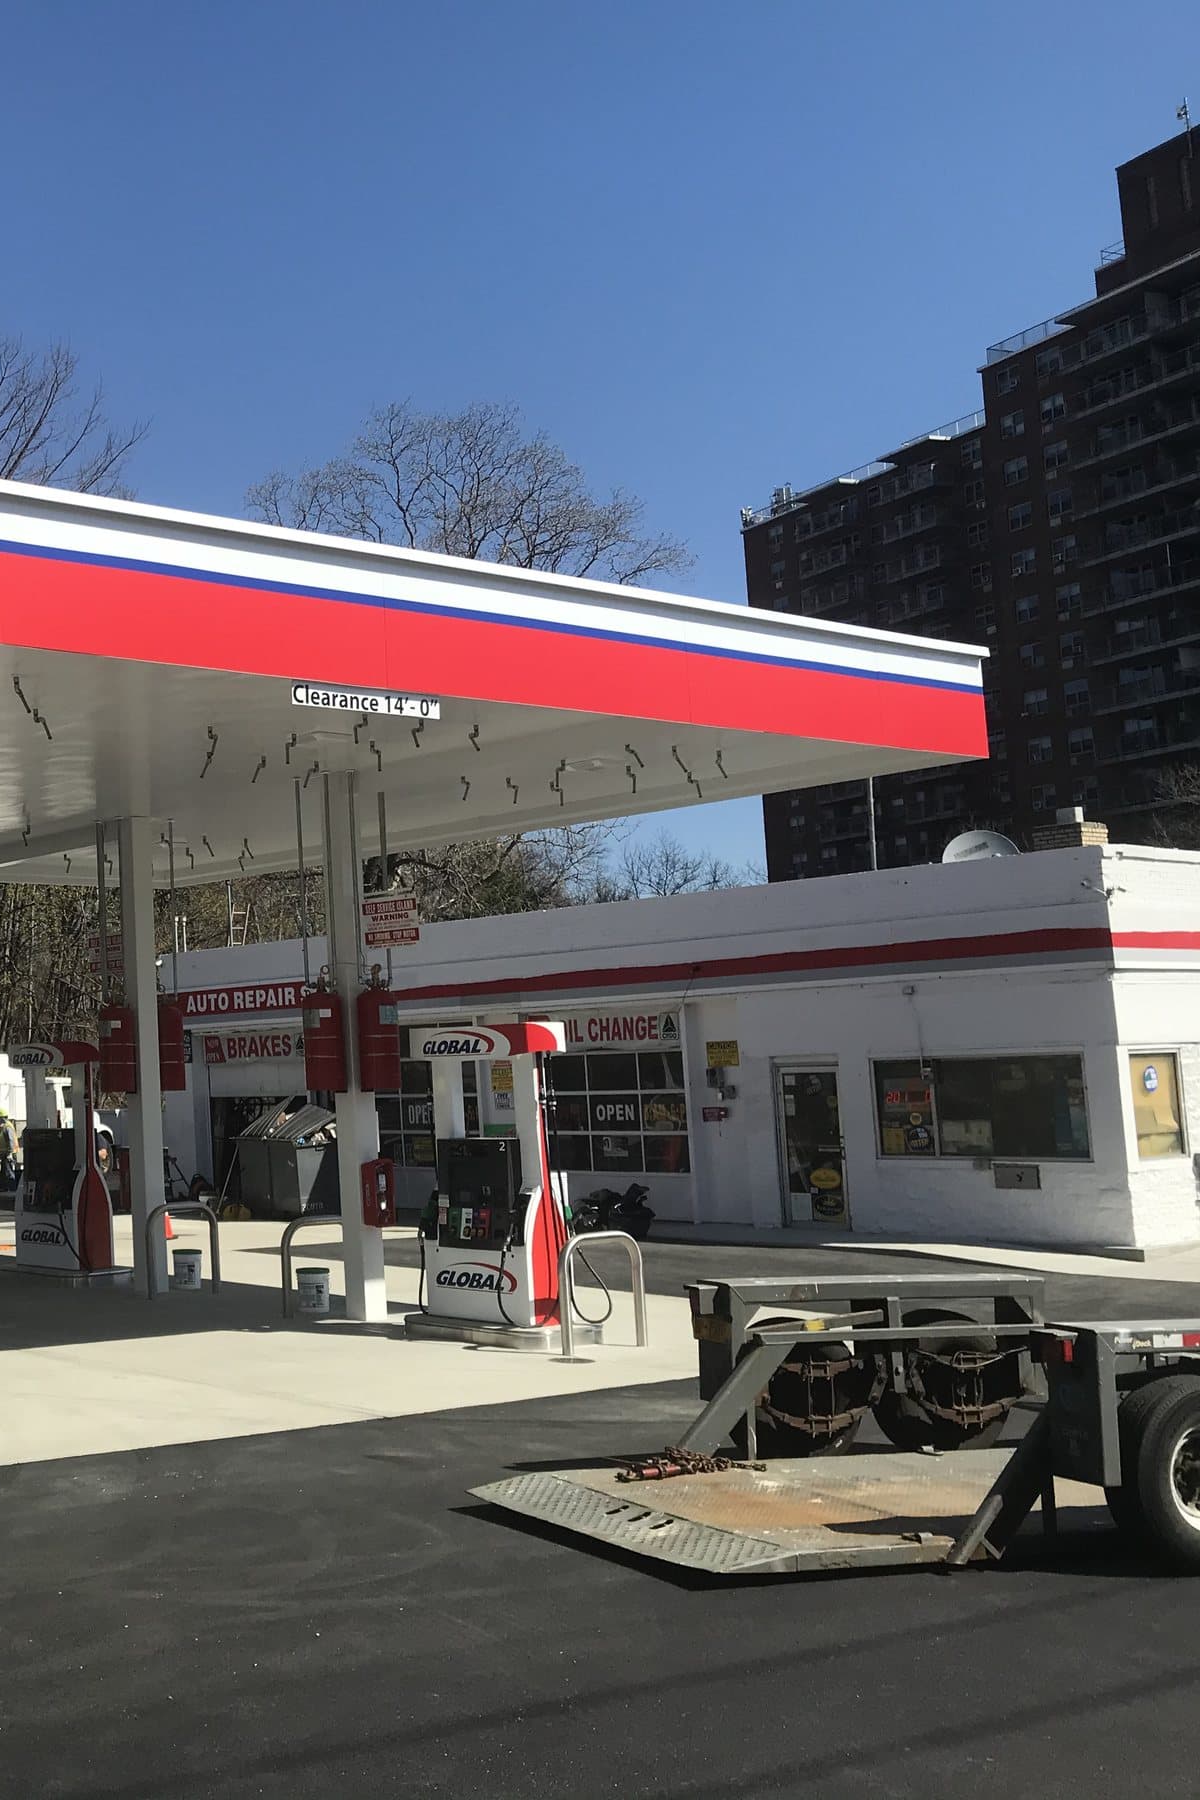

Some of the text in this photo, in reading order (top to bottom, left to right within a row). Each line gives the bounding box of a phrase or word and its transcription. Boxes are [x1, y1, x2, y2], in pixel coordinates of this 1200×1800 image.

[292, 685, 379, 711] Clearance
[371, 912, 409, 922] WARNING
[186, 992, 229, 1013] AUTO
[233, 987, 296, 1009] REPAIR
[587, 1015, 659, 1042] CHANGE
[227, 1034, 292, 1059] BRAKES
[422, 1038, 482, 1055] GLOBAL
[596, 1104, 635, 1121] OPEN
[499, 1141, 506, 1151] 2
[21, 1229, 63, 1244] GLOBAL
[435, 1270, 505, 1291] GLOBAL
